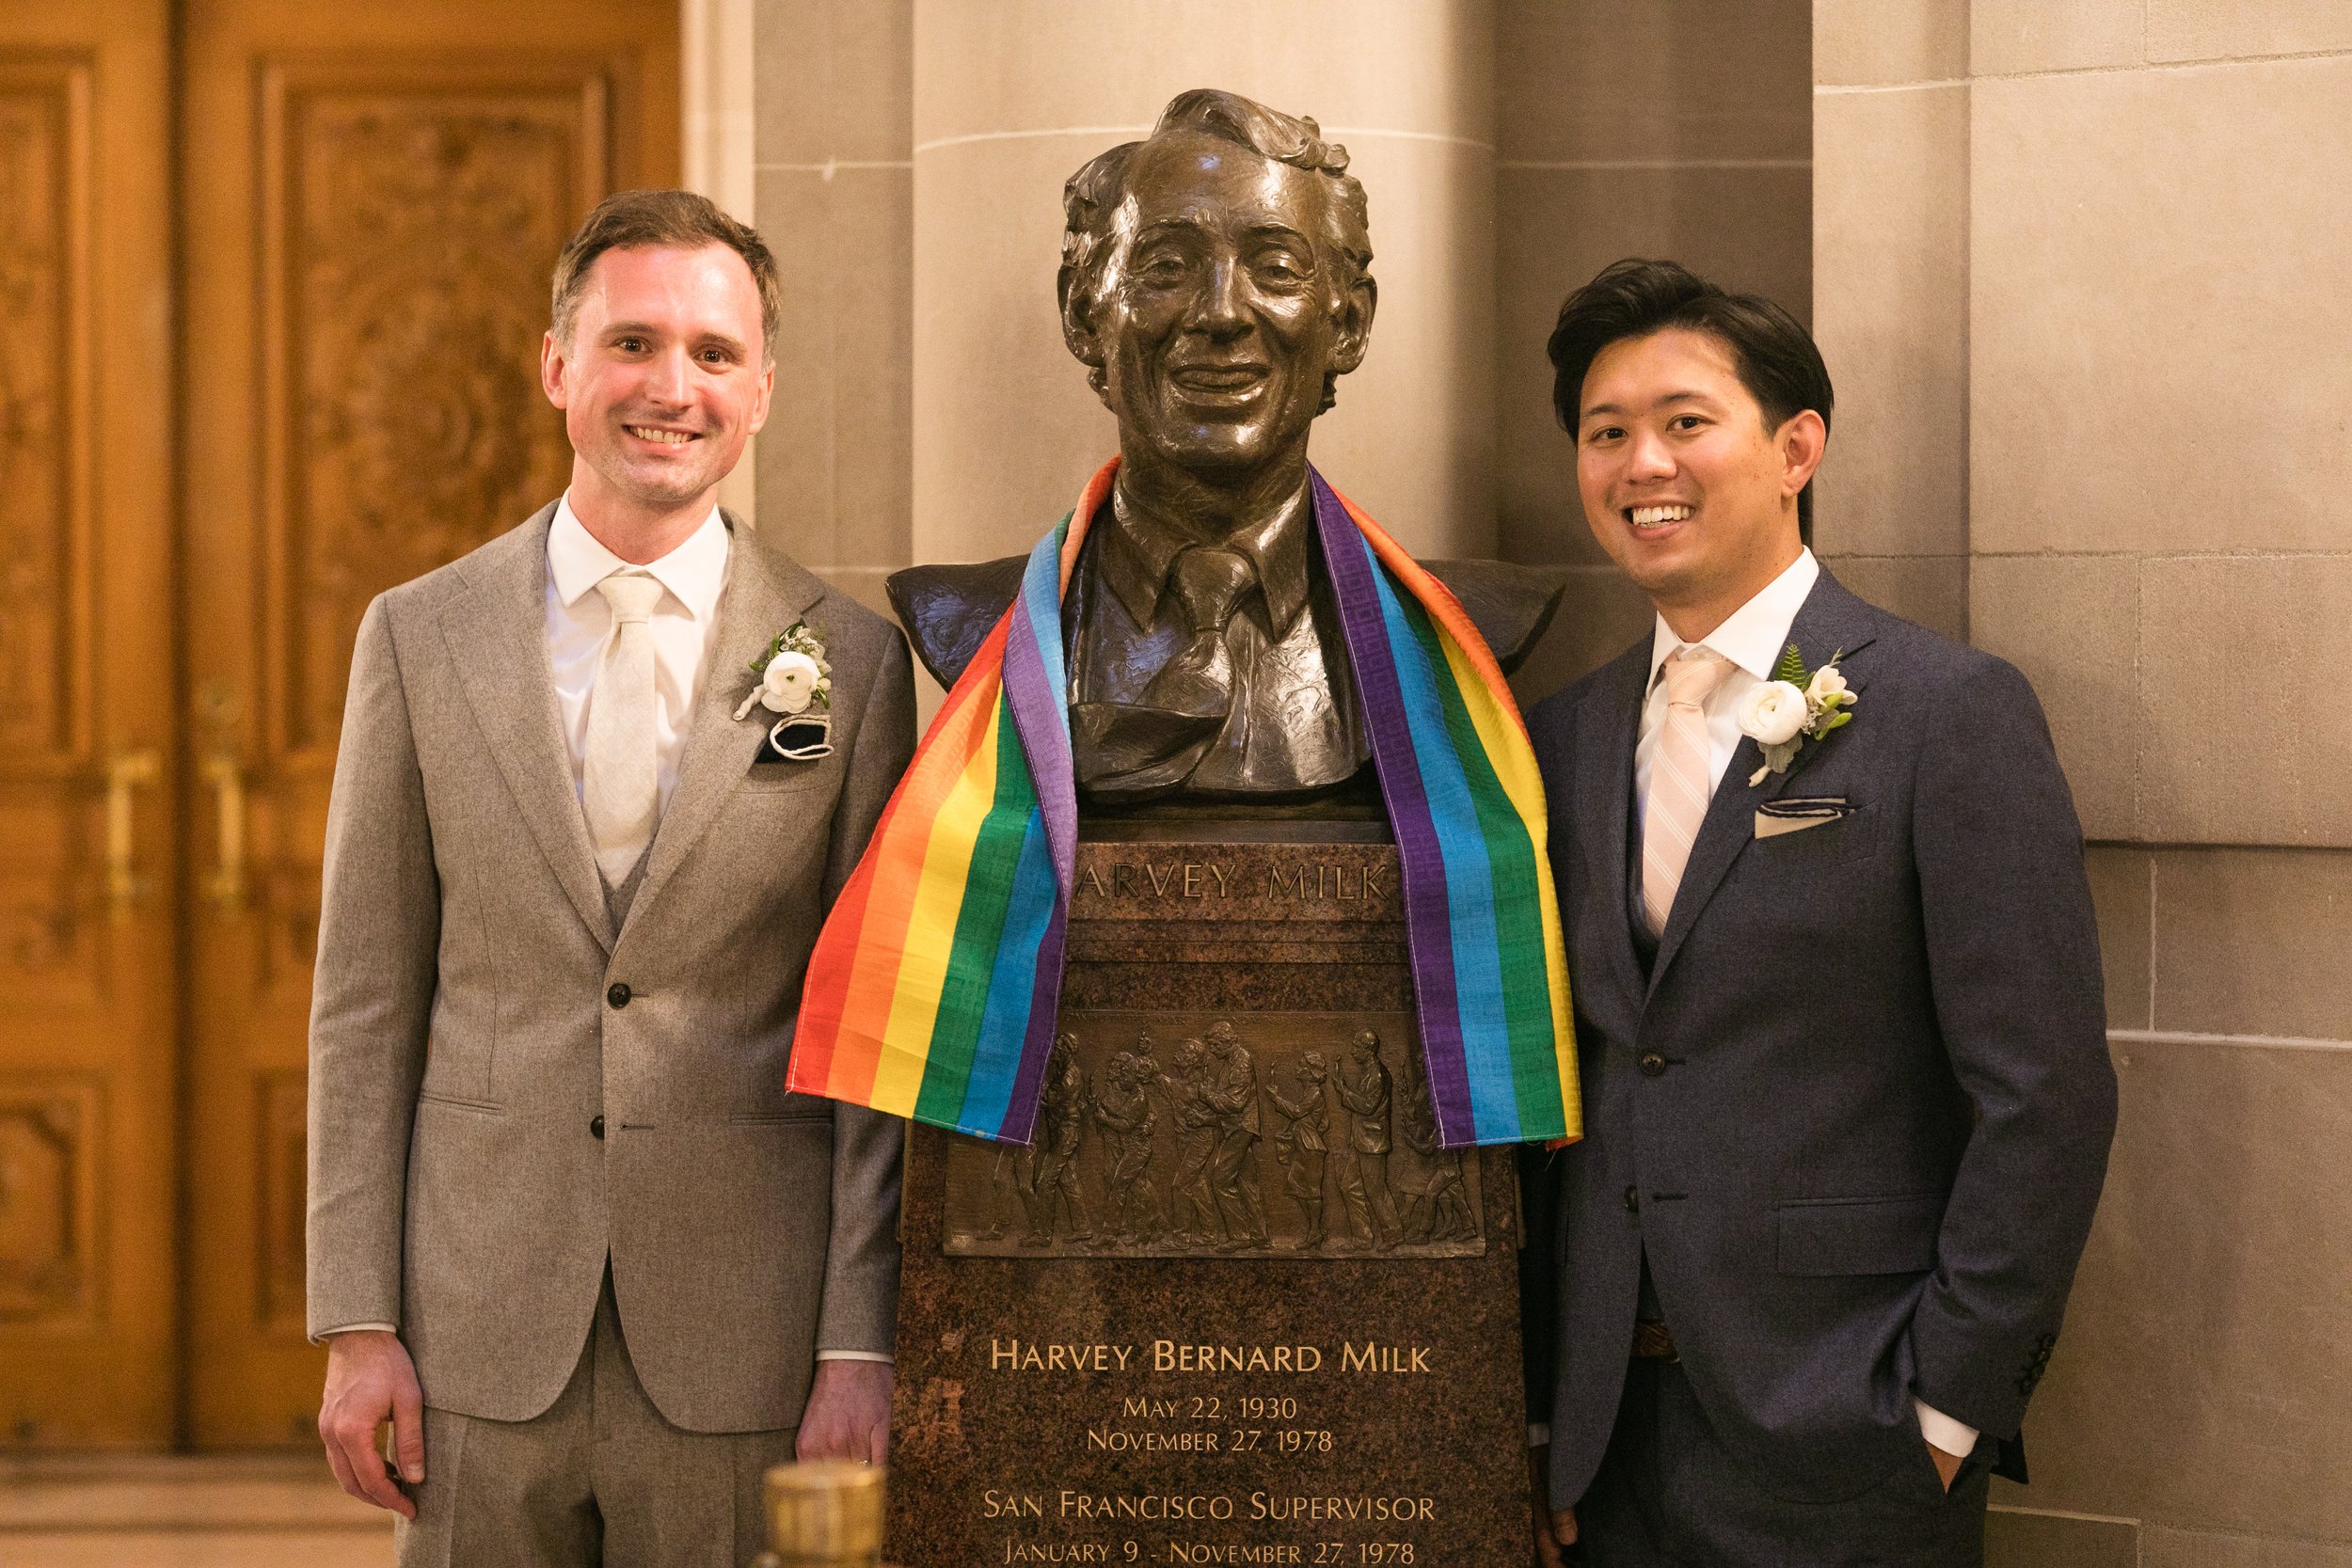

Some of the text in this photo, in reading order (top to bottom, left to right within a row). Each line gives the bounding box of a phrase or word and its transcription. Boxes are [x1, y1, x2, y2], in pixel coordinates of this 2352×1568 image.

[1076, 863, 1388, 900] ARVEY MILK
[991, 1338, 1432, 1373] HARVEY BERNARD MILK
[1122, 1397, 1297, 1420] MAY 22, 1930
[1088, 1429, 1332, 1454] NOVEMBER 27, 1978
[983, 1489, 1436, 1522] SAN FRANCISCO SUPERVISOR
[1004, 1541, 1110, 1563] JANUARY
[1123, 1541, 1138, 1562] 9
[1169, 1542, 1302, 1564] NOVEMBER
[1314, 1543, 1345, 1566] 27,
[1358, 1543, 1415, 1565] 1978
